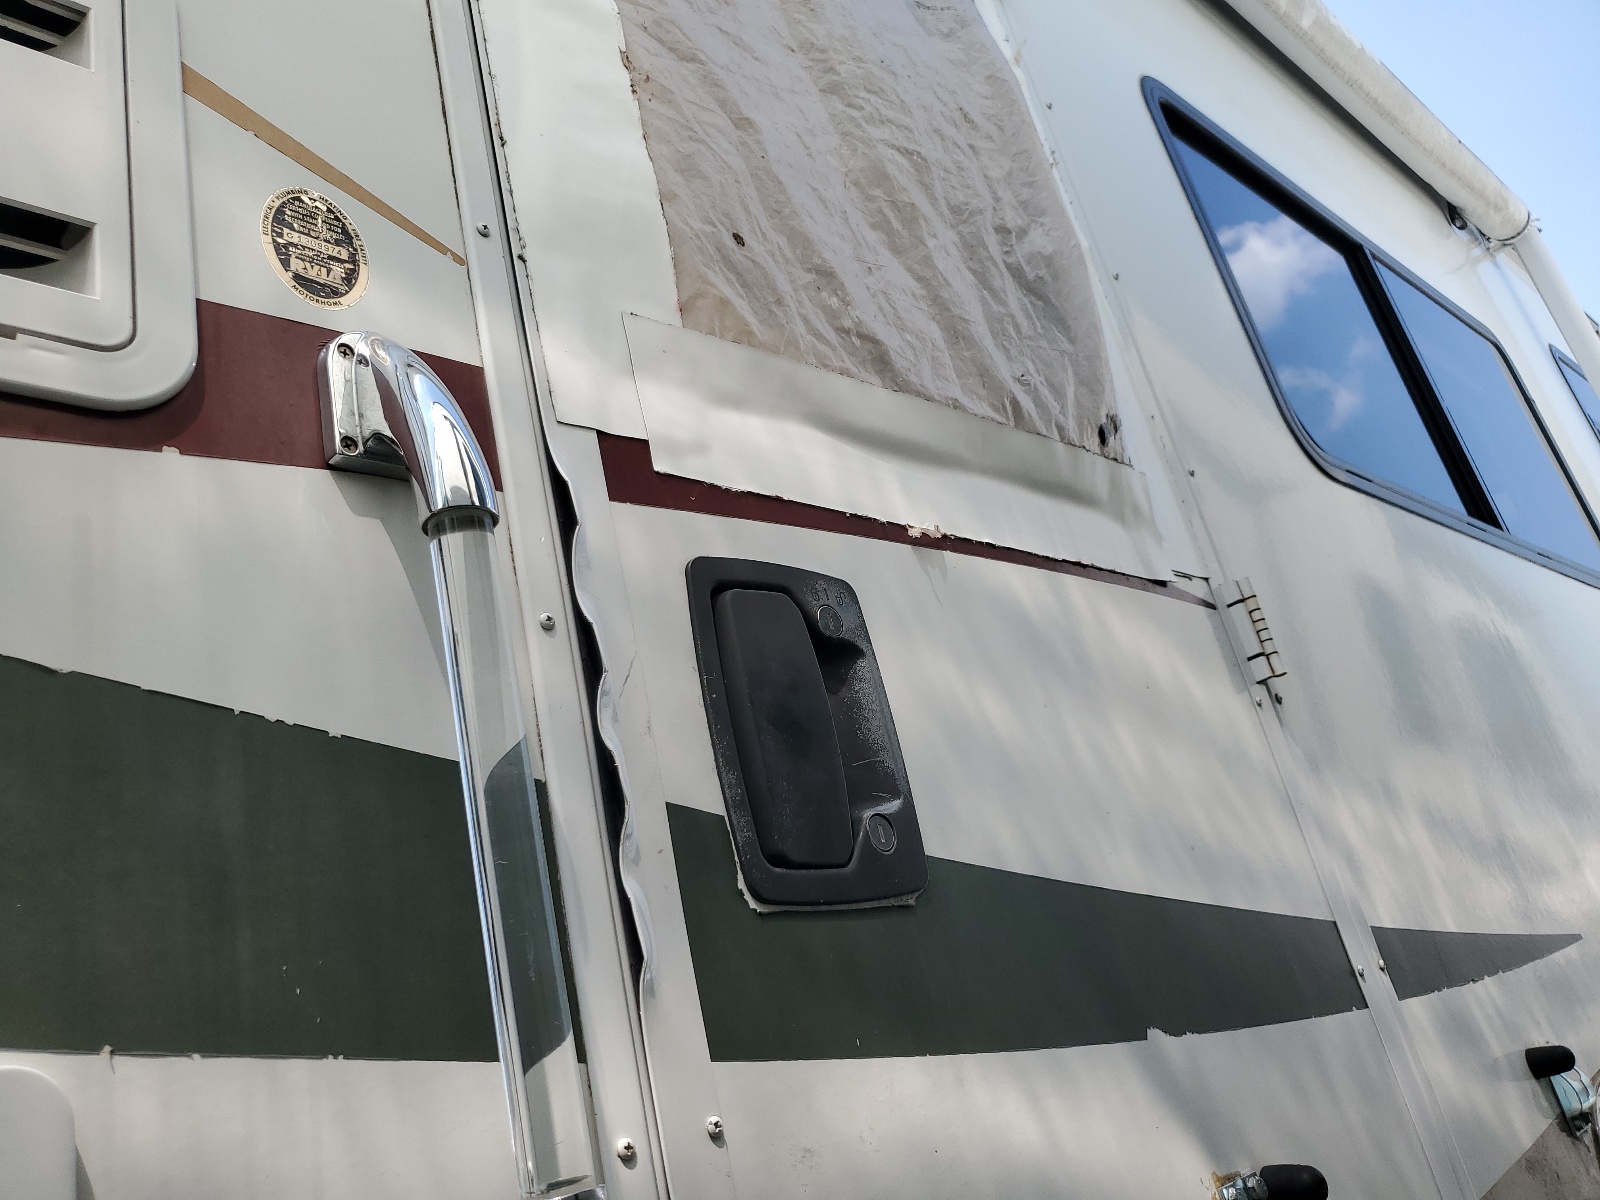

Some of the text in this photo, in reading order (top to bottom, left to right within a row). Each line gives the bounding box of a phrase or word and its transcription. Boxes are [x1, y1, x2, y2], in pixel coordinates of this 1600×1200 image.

[262, 203, 274, 236] ELECTRICAL
[276, 188, 309, 201] PLUMBING
[319, 195, 348, 221] HEATING
[289, 257, 343, 283] RVIA
[291, 284, 343, 306] MOTORHOME
